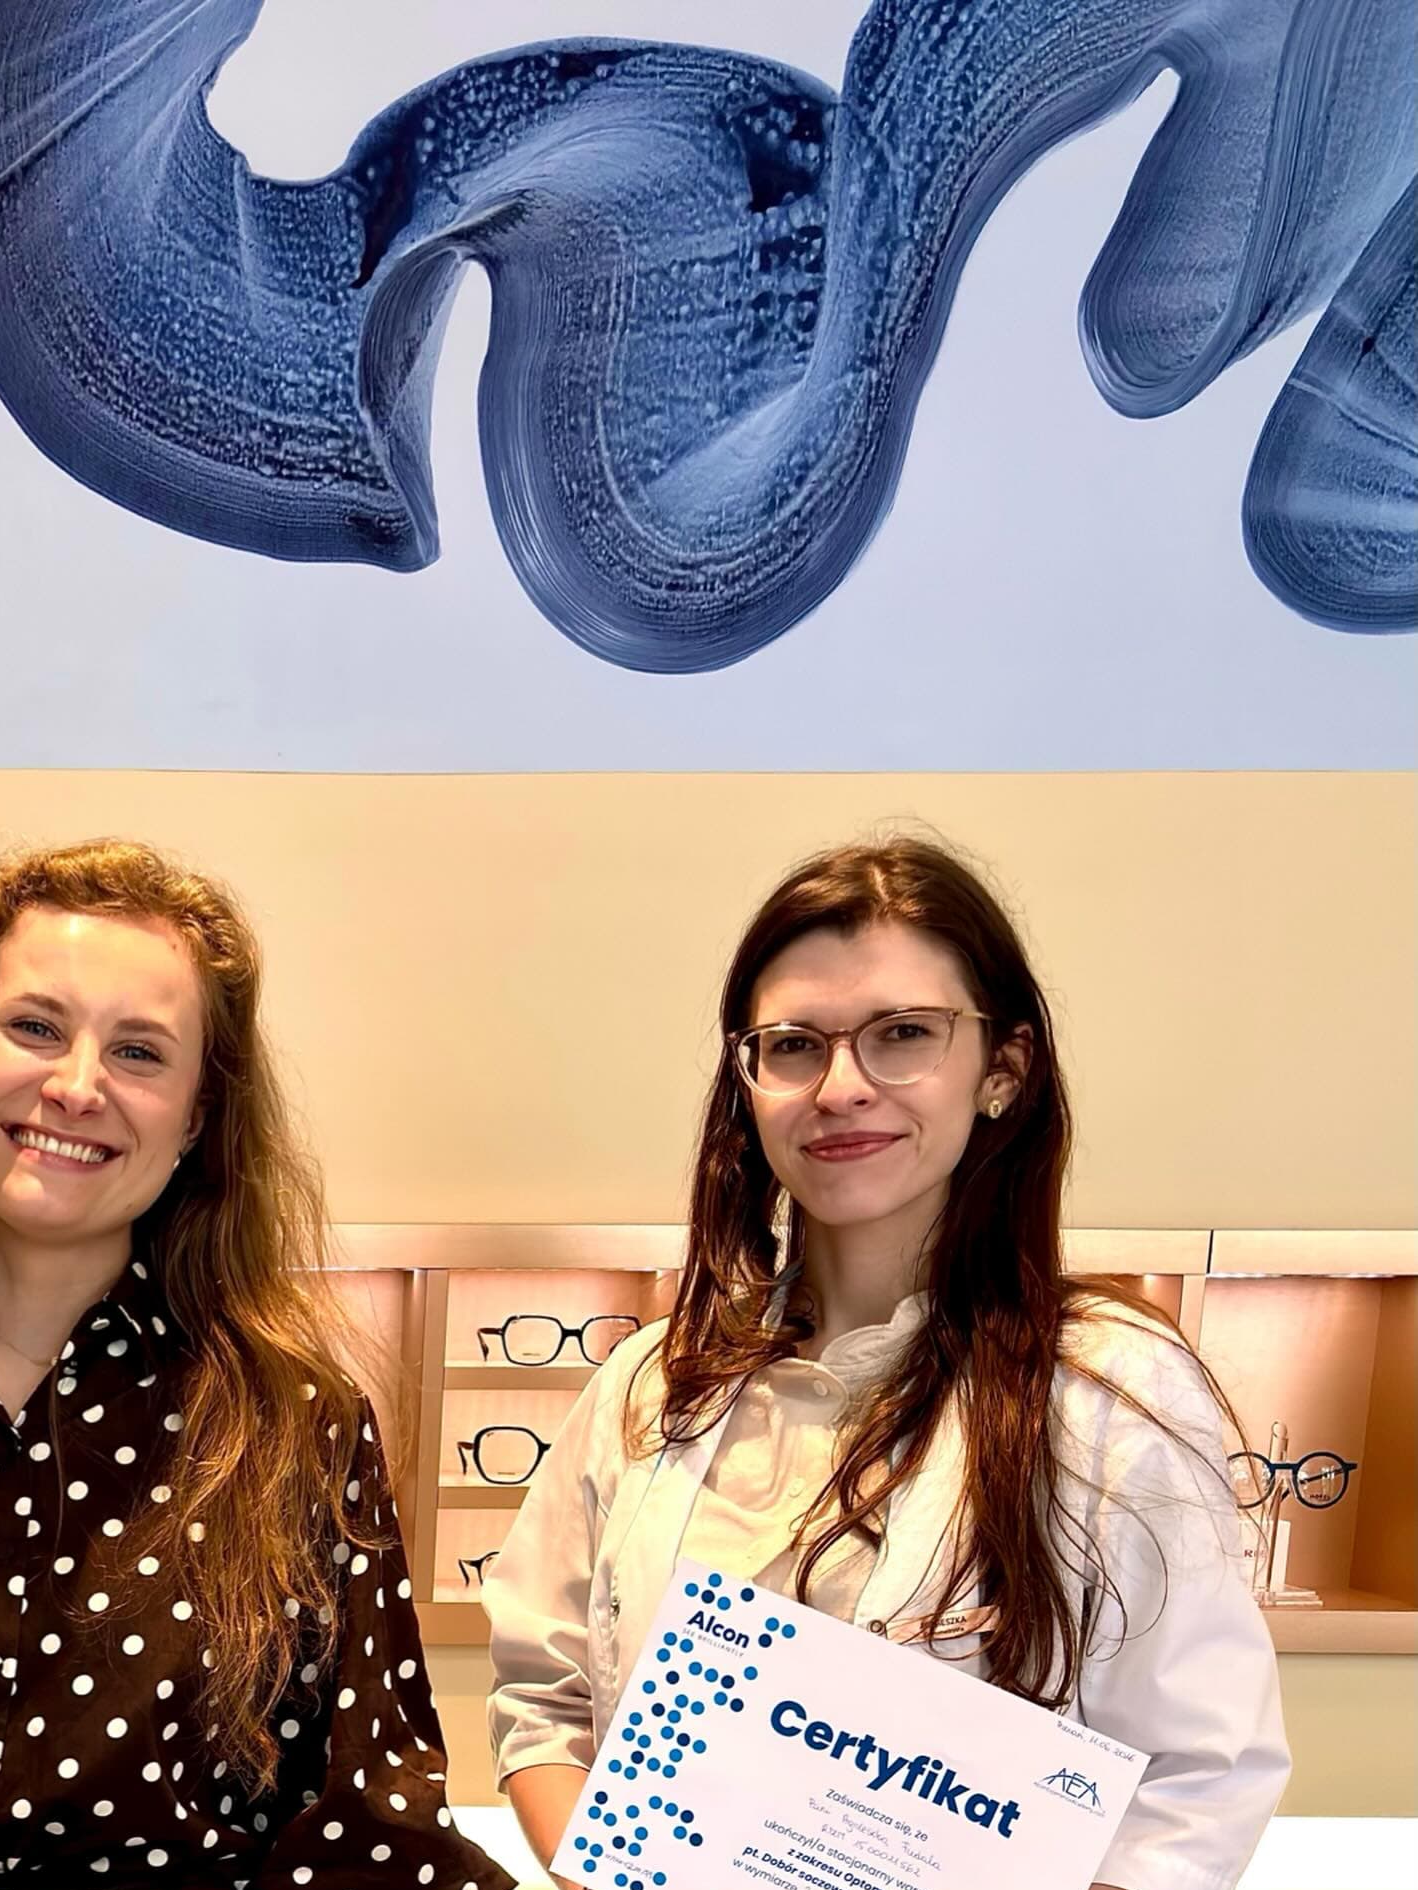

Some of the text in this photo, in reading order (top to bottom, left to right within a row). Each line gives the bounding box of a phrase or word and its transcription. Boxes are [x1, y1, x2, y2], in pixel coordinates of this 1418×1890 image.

[687, 1610, 749, 1649] Alcon
[770, 1700, 1021, 1839] Certyfikat
[826, 1788, 893, 1826] Zaświadcza
[733, 1858, 744, 1868] w
[742, 1845, 759, 1859] pt.
[761, 1853, 798, 1875] Dobór
[764, 1818, 826, 1854] ukończył/a
[826, 1847, 894, 1886] stacjonarny
[786, 1847, 795, 1857] z
[795, 1850, 845, 1878] zakresu
